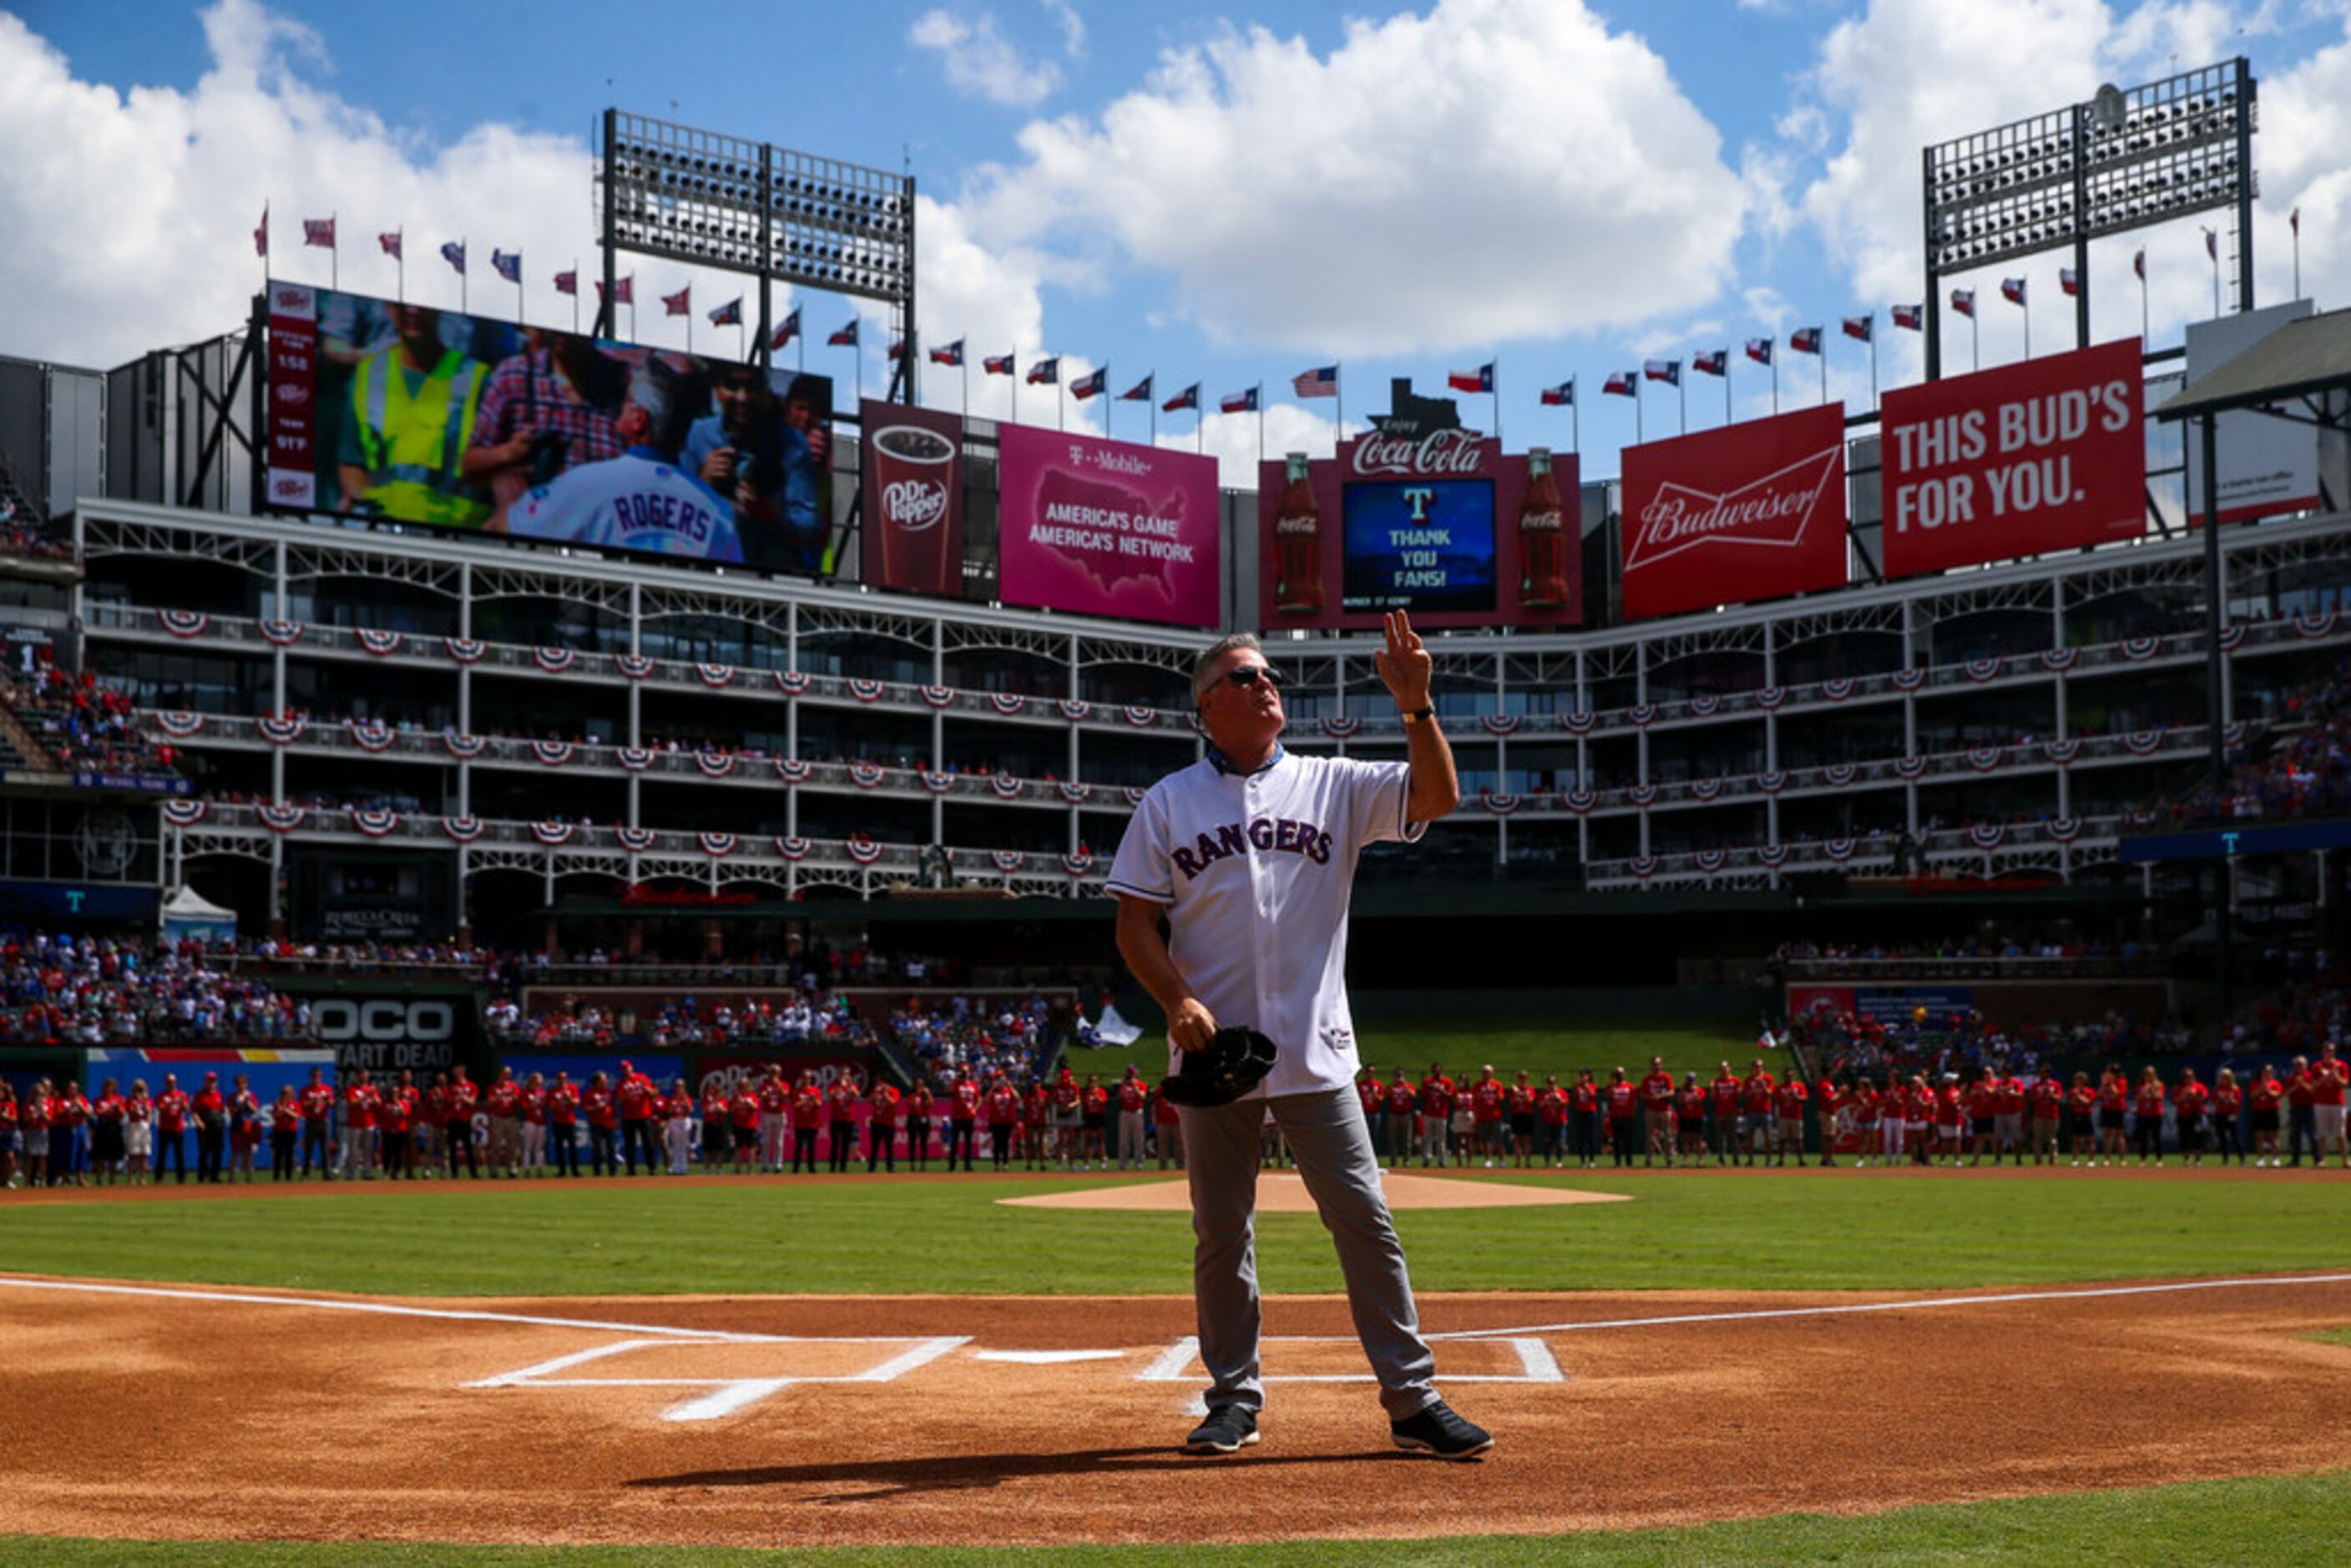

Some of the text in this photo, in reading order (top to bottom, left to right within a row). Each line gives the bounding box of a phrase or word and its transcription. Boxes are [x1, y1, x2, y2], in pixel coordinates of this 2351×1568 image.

[1893, 380, 2129, 473] THIS BUD'S
[884, 482, 943, 524] Pepper
[905, 479, 929, 501] Dr
[1403, 487, 1434, 524] T
[1897, 456, 2086, 533] FOR YOU.
[613, 493, 710, 542] ROGERS
[1046, 503, 1178, 539] AMERICA'S GAME
[1641, 486, 1817, 544] Budweiser
[1029, 524, 1194, 563] AMERICA'S NETWORK
[1388, 529, 1451, 546] THANK
[1401, 550, 1437, 567] YOU
[1393, 571, 1447, 588] FANS!
[1171, 817, 1332, 881] RANGERS
[64, 890, 86, 913] T
[310, 999, 454, 1041] OCO
[326, 1043, 454, 1068] TART DEAD
